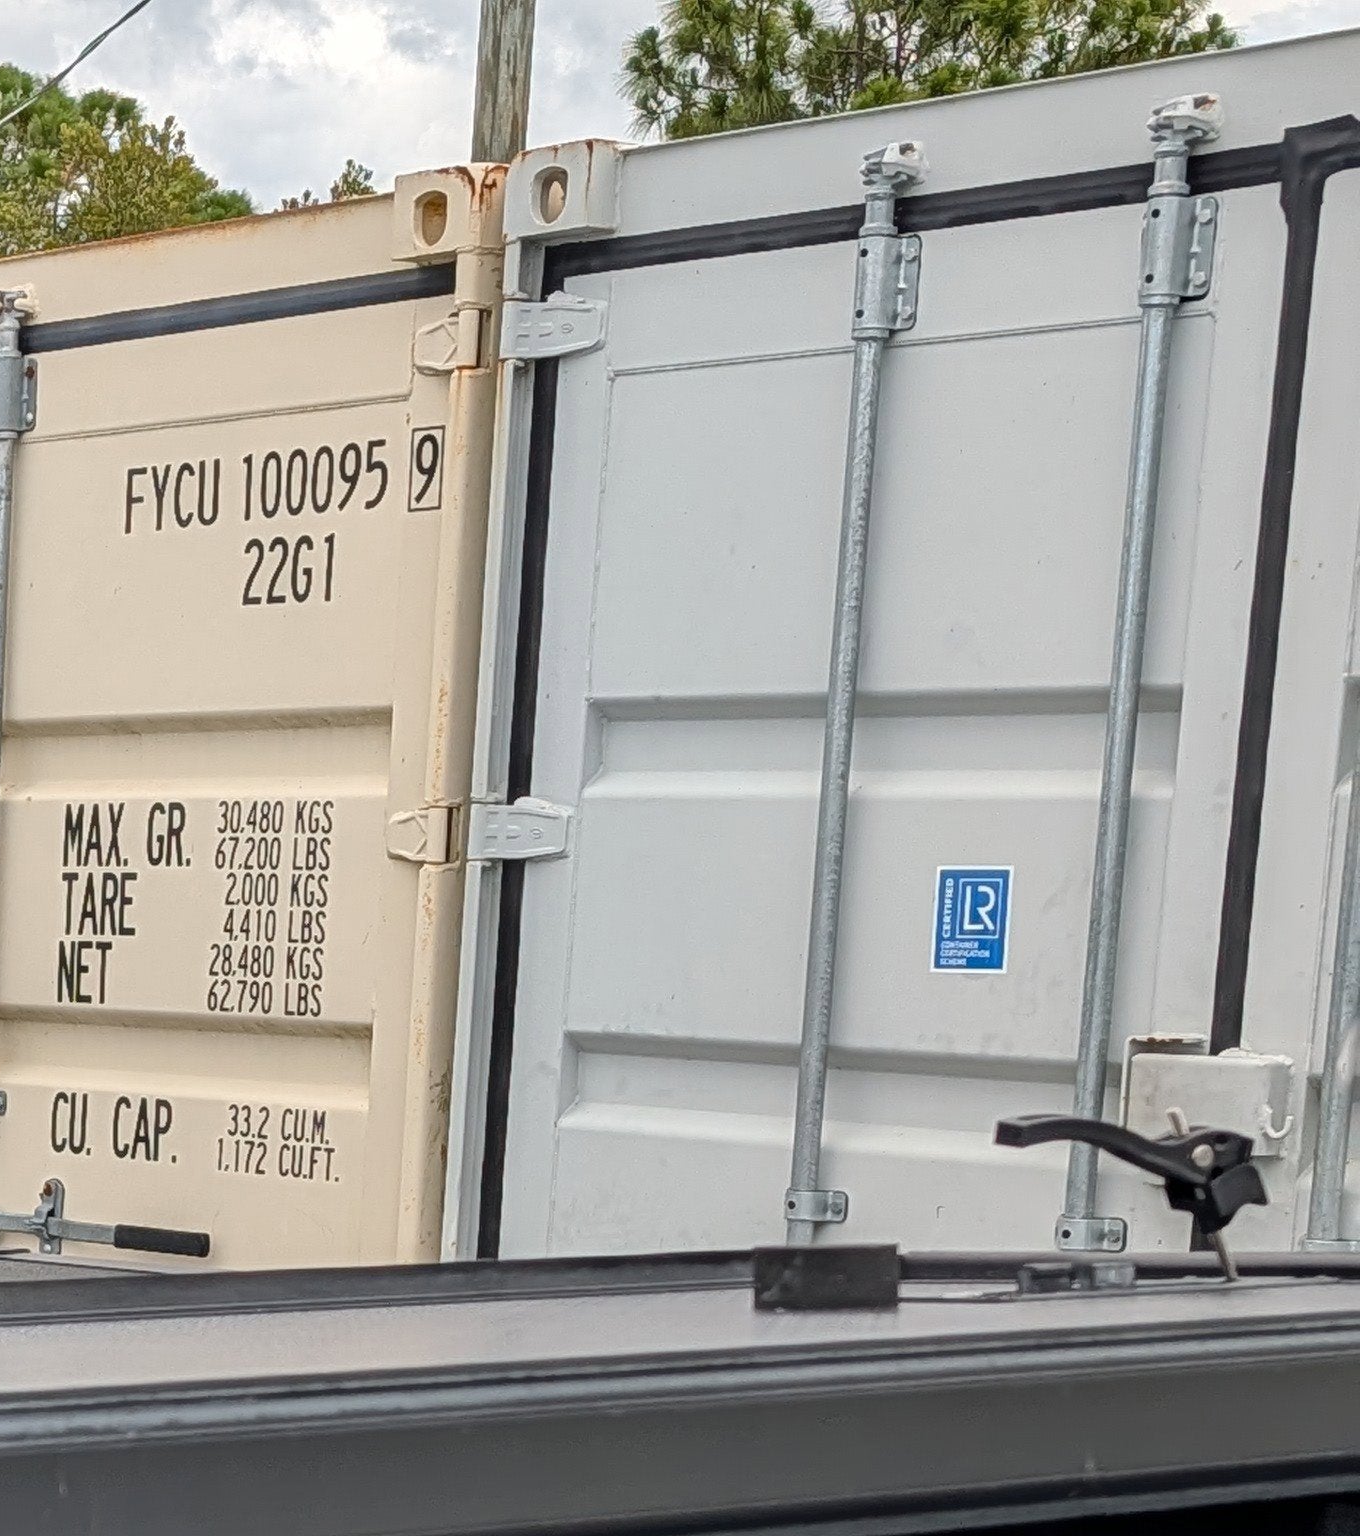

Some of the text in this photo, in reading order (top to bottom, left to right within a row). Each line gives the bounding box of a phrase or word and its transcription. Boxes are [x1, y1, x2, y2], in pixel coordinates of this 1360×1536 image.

[124, 433, 439, 534] FYCU 100095 9
[242, 533, 335, 606] 22G1
[62, 800, 334, 867] MAX. GR. 30,480 KGS
[214, 836, 332, 871] 67,200 LBS
[62, 872, 137, 936] TARE
[289, 873, 330, 907] KGS
[223, 908, 327, 945] 4,410 LBS
[963, 885, 996, 930] LR
[57, 941, 324, 1004] NET 28,480 KGS
[207, 980, 323, 1017] 62,790 LBS
[51, 1092, 329, 1163] CU. CAP. 33.2 CU.M.
[278, 1143, 339, 1183] CU.FT.
